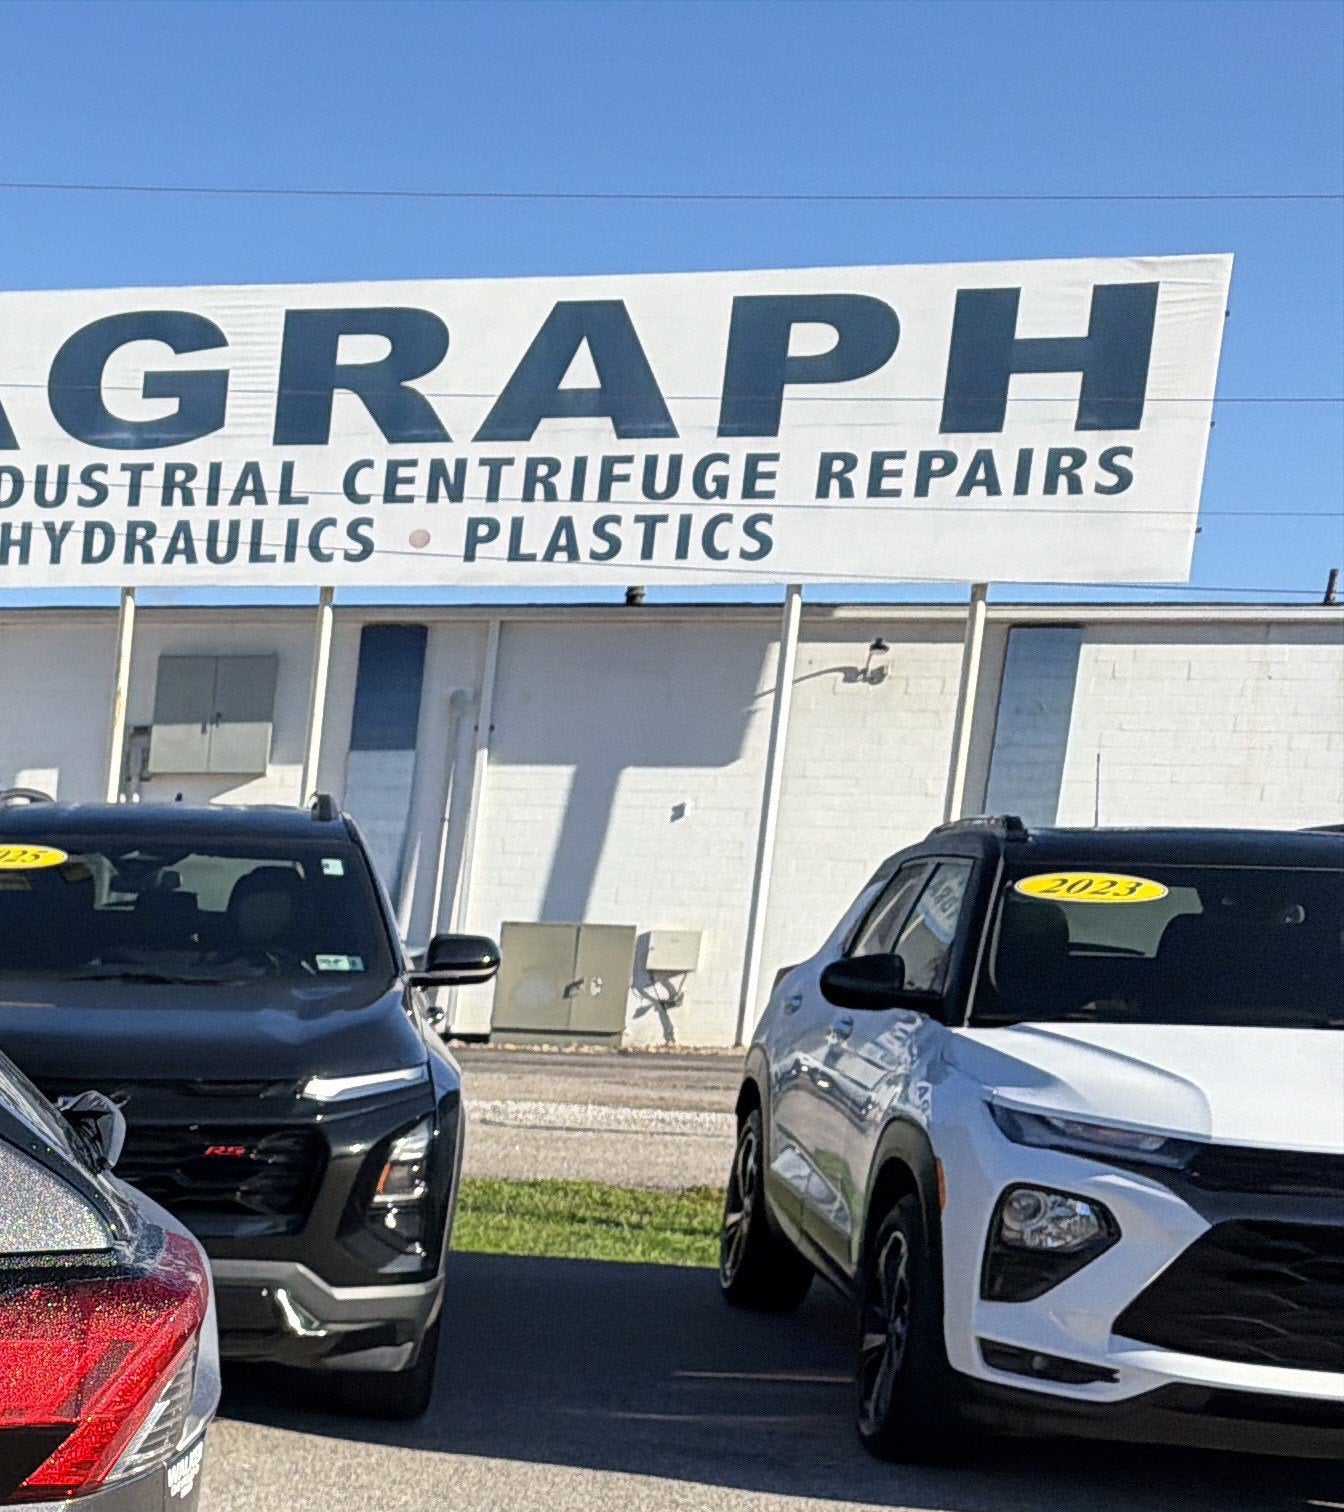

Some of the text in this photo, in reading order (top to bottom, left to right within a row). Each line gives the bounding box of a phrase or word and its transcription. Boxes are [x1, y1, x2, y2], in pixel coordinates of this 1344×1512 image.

[343, 453, 779, 504] CENTRIFUGE
[816, 447, 1132, 498] REPAIRS
[0, 518, 374, 565] HYDRAULICS
[464, 514, 772, 562] PLASTICS
[1037, 878, 1143, 897] 2023
